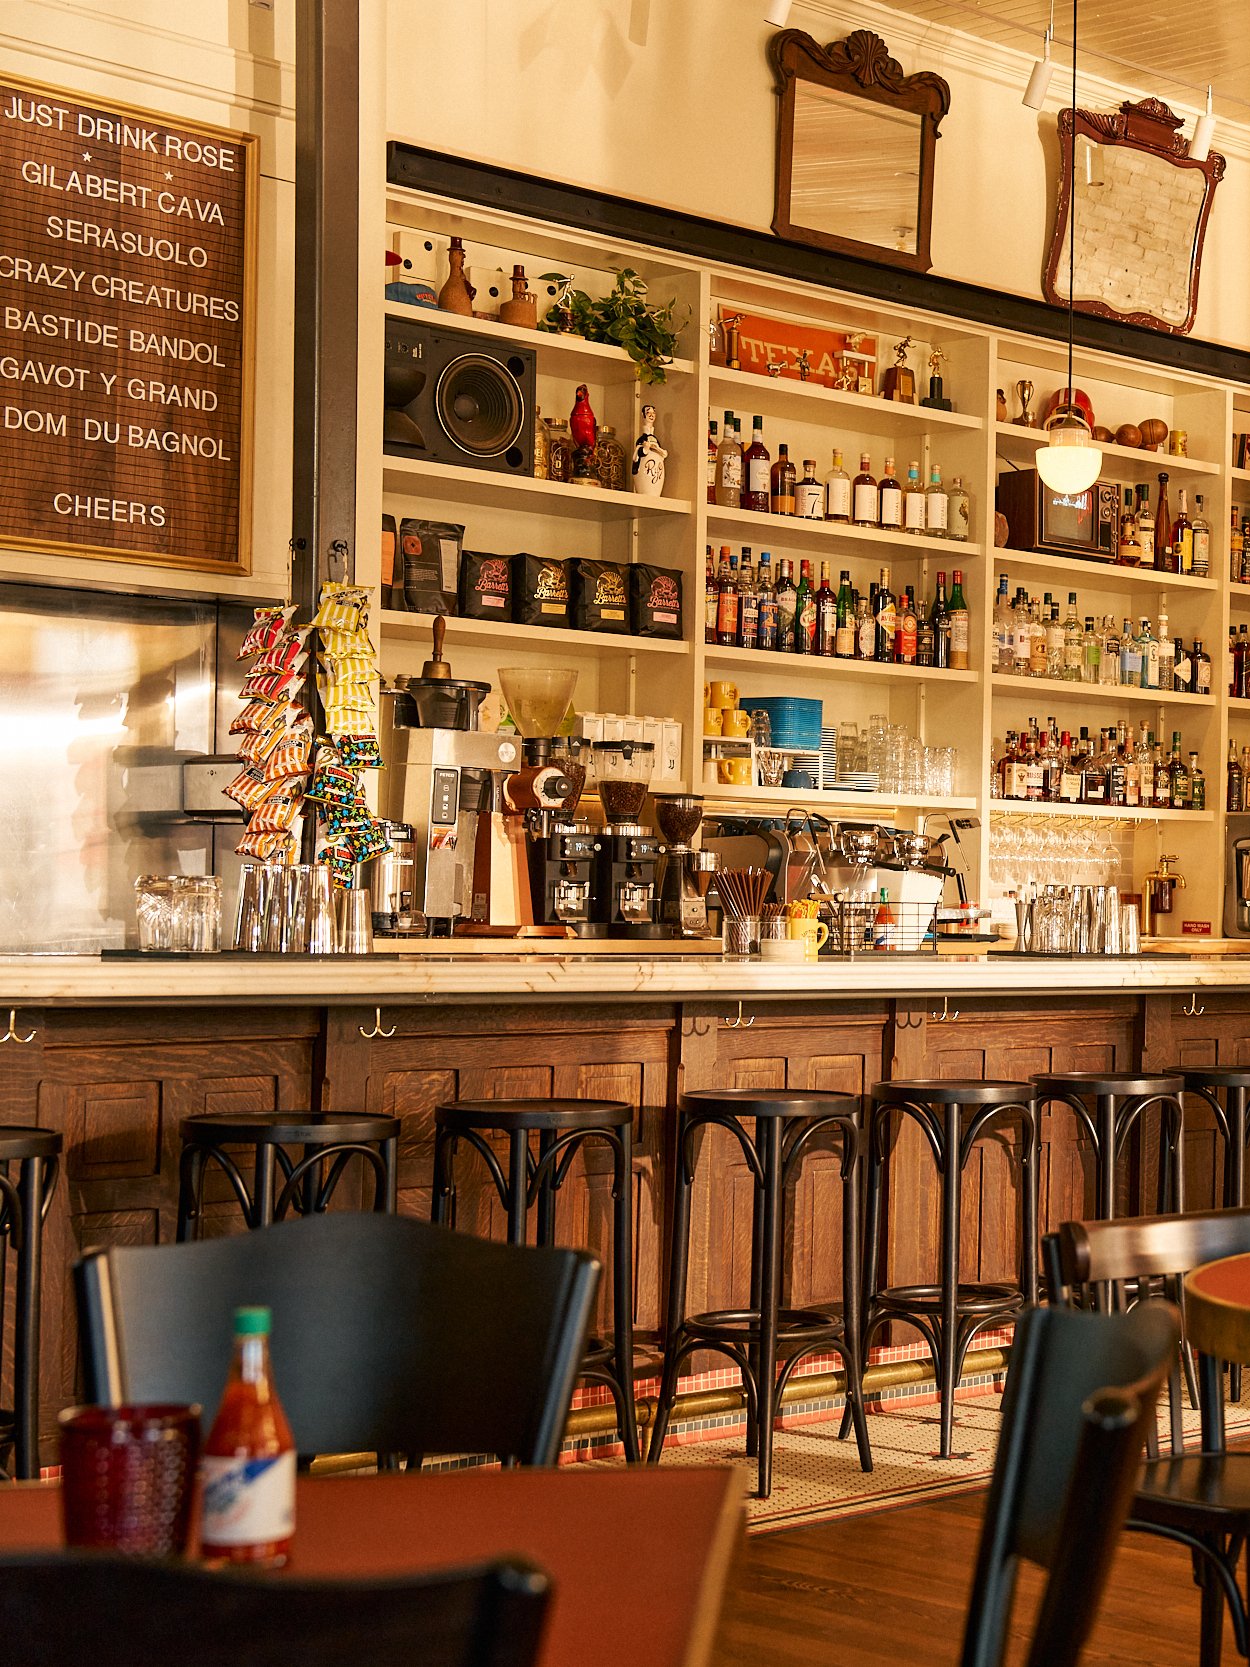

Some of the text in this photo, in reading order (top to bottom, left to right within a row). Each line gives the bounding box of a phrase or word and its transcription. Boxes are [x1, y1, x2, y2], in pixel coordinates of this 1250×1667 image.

[5, 97, 235, 172] JUST DRINK ROSE
[22, 161, 226, 227] GILABERT CAVA
[46, 216, 208, 269] SERASUOLO
[0, 255, 240, 322] CRAZY CREATURES
[5, 307, 226, 367] BASTIDE BANDOL
[0, 356, 218, 412] GAVOT Y GRAND
[4, 406, 231, 461] DOM DU BAGNOL
[53, 493, 167, 527] CHEERS
[474, 578, 509, 593] Barrett's
[533, 587, 569, 600] Barrett's
[593, 592, 627, 605] Barrett's
[646, 597, 680, 609] Barrett's
